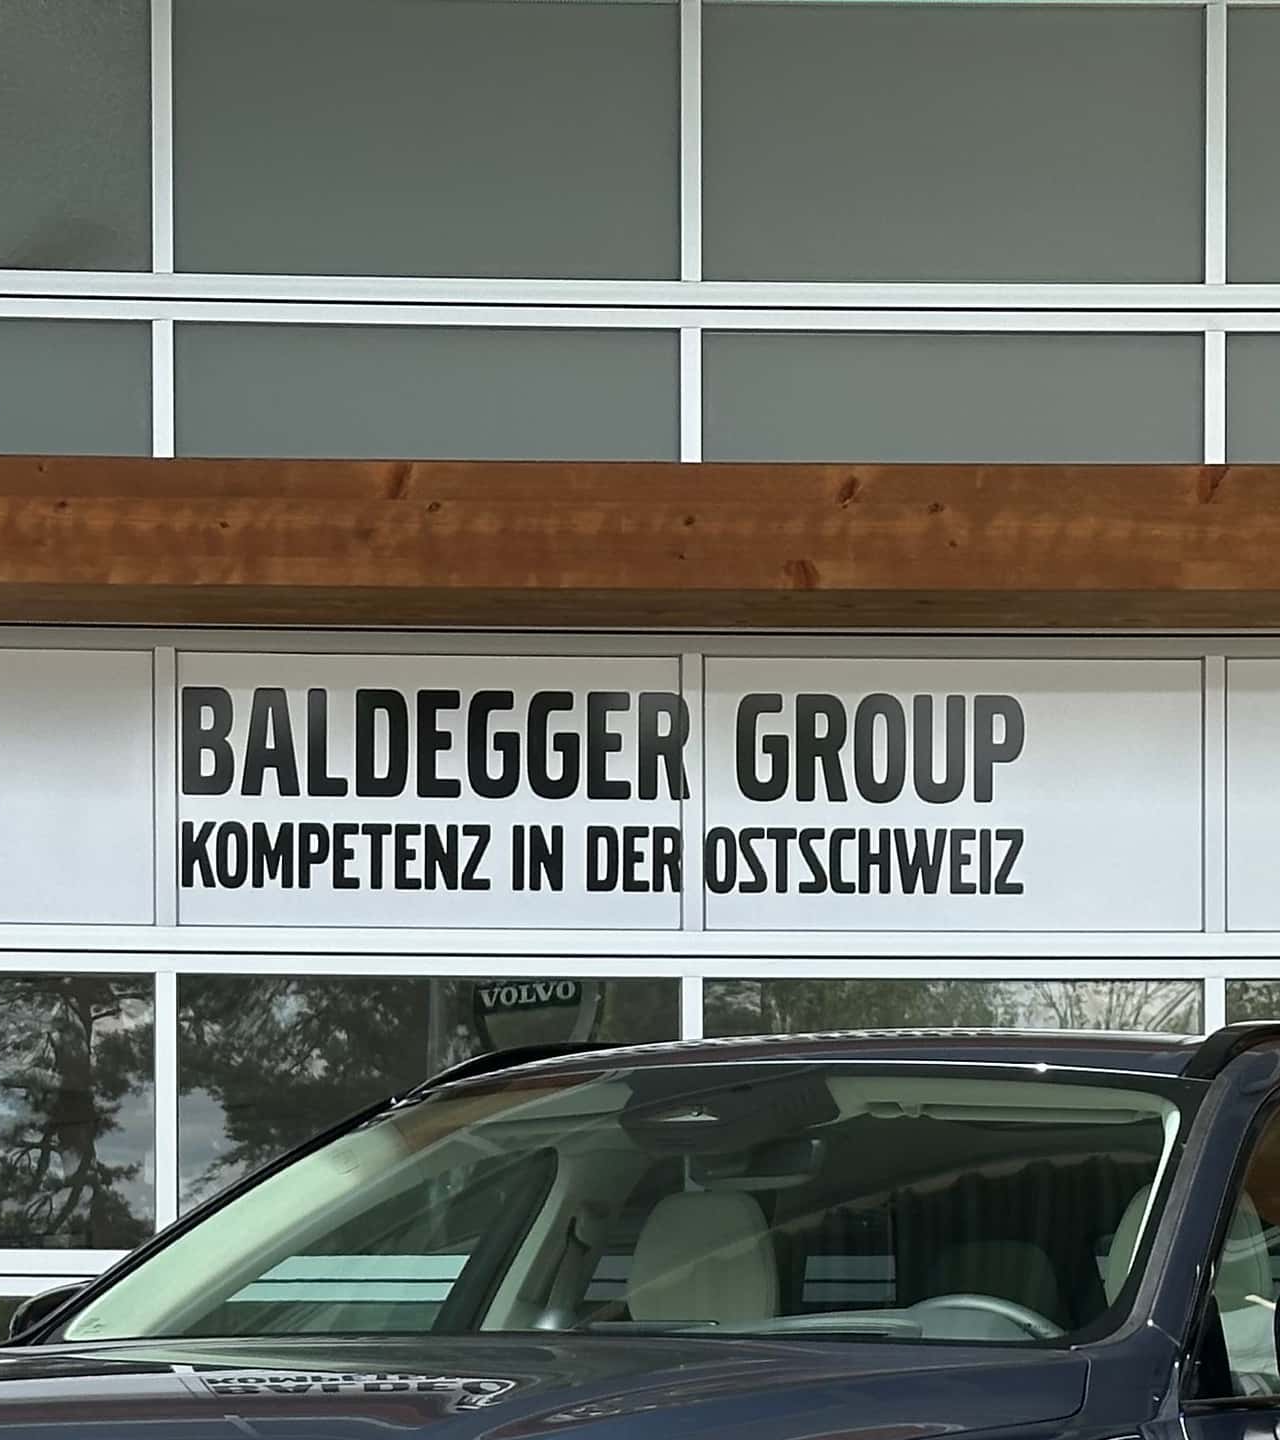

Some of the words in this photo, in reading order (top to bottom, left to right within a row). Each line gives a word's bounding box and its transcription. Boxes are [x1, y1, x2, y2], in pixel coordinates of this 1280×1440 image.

[181, 686, 690, 800] BALDEGGER
[736, 692, 1025, 804] GROUP
[181, 821, 491, 889] KOMPETENZ
[512, 825, 563, 891] IN
[586, 826, 682, 892] DER
[704, 827, 1024, 894] OSTSCHWEIZ
[478, 980, 576, 1009] VOLVO
